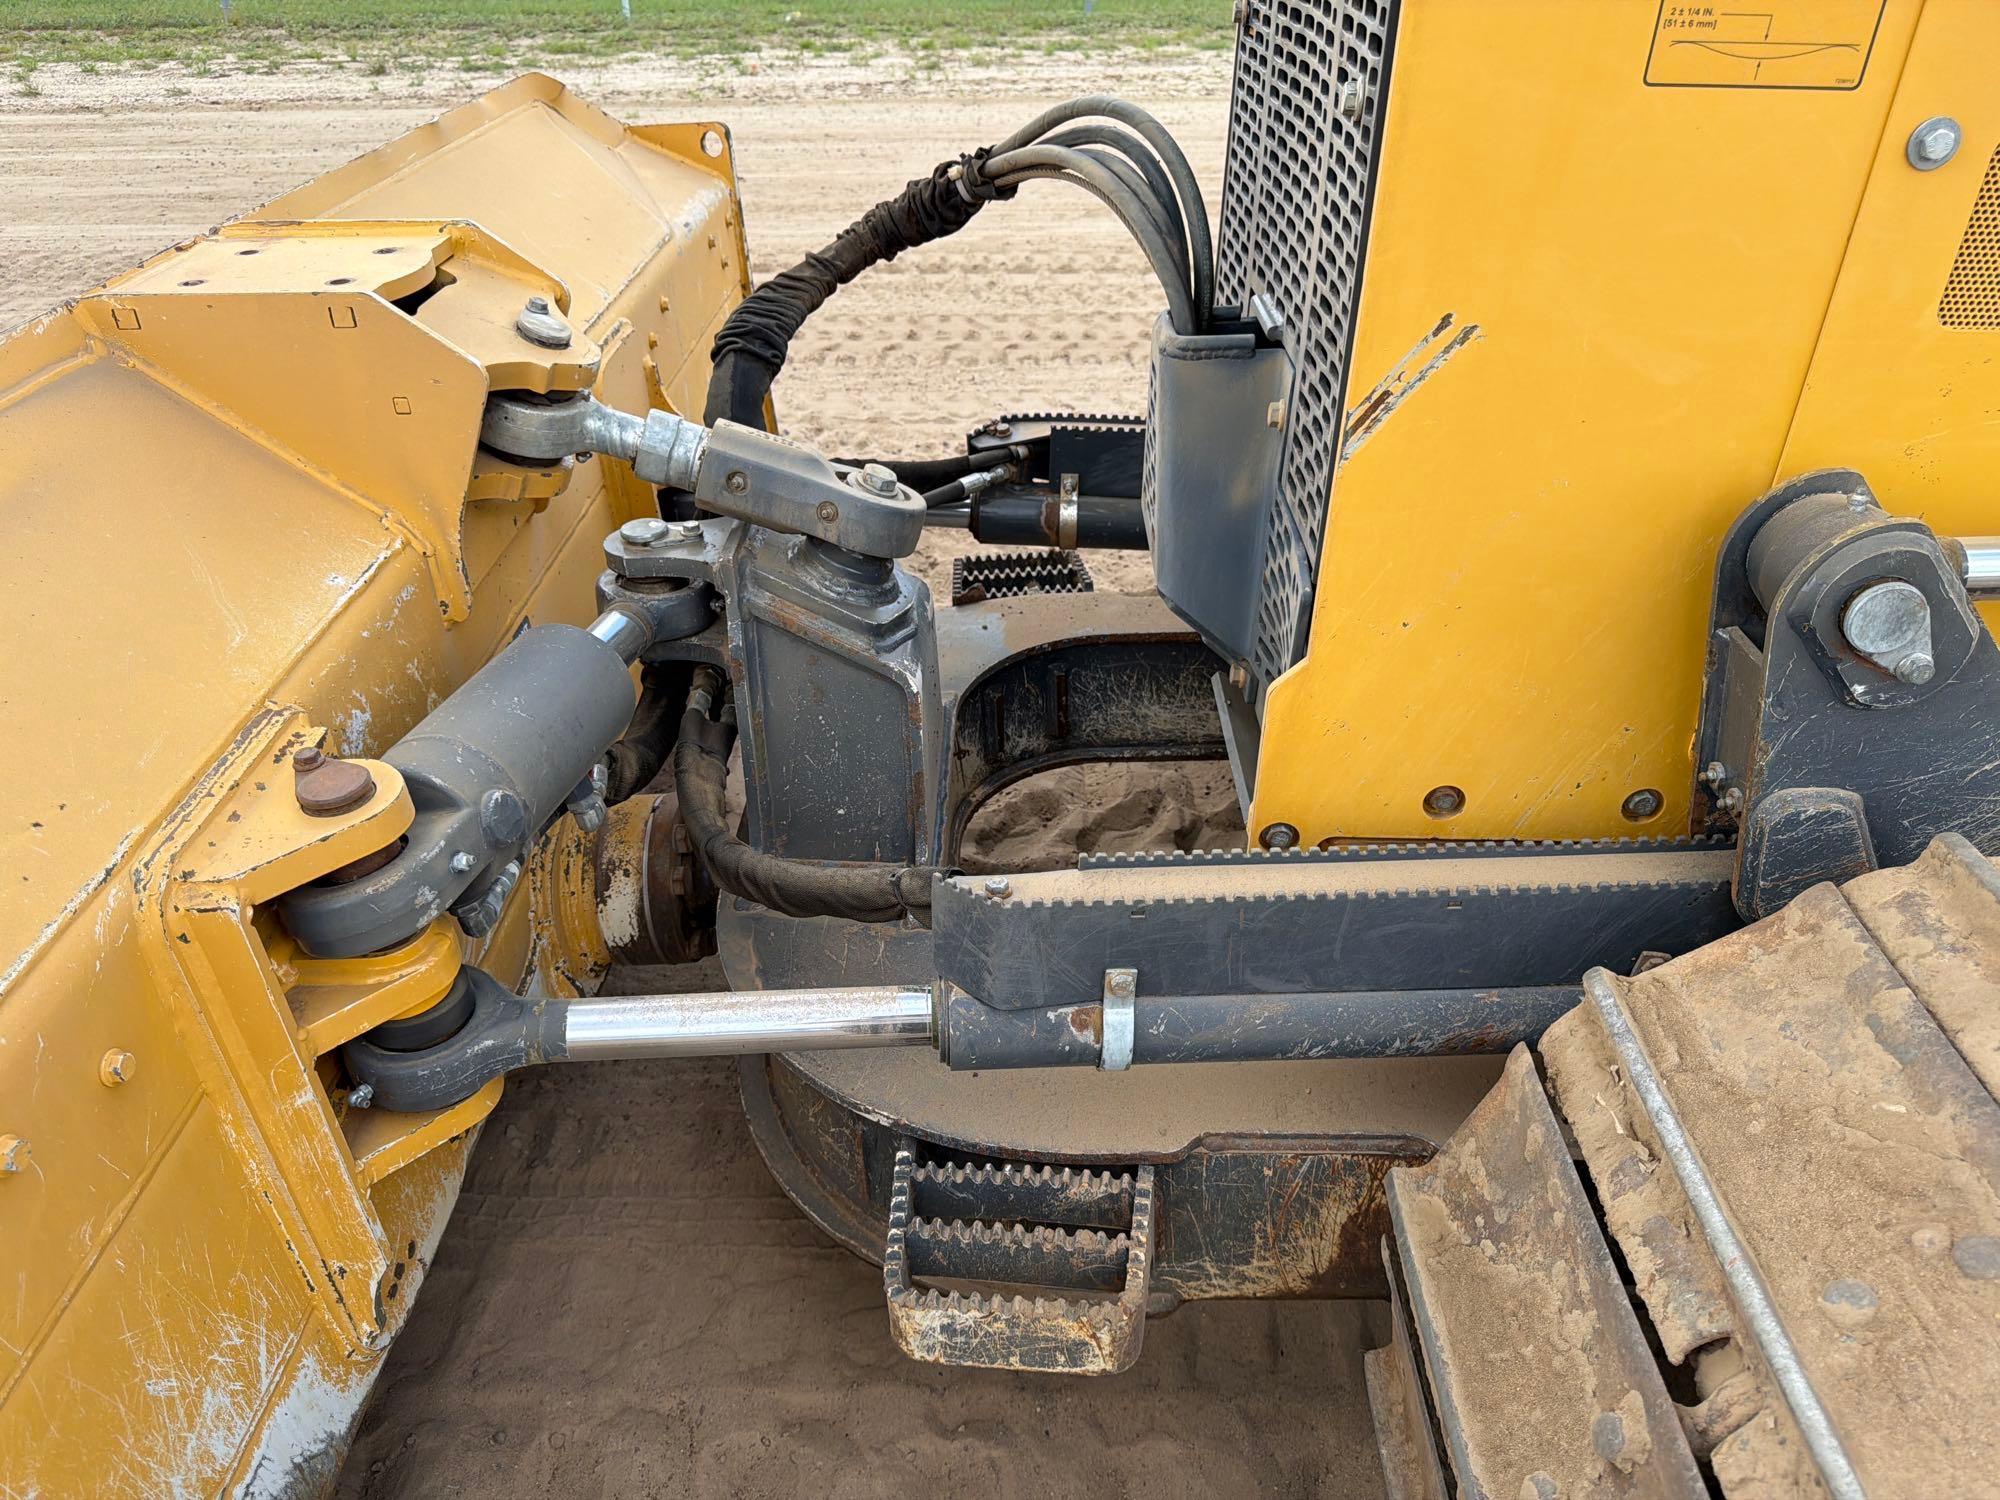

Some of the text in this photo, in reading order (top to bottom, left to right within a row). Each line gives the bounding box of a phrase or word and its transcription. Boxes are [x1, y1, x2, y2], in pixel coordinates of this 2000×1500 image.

[1670, 7, 1714, 16] 2 ± 1/4 IN.
[1663, 18, 1717, 30] [51 ± 6 mm]
